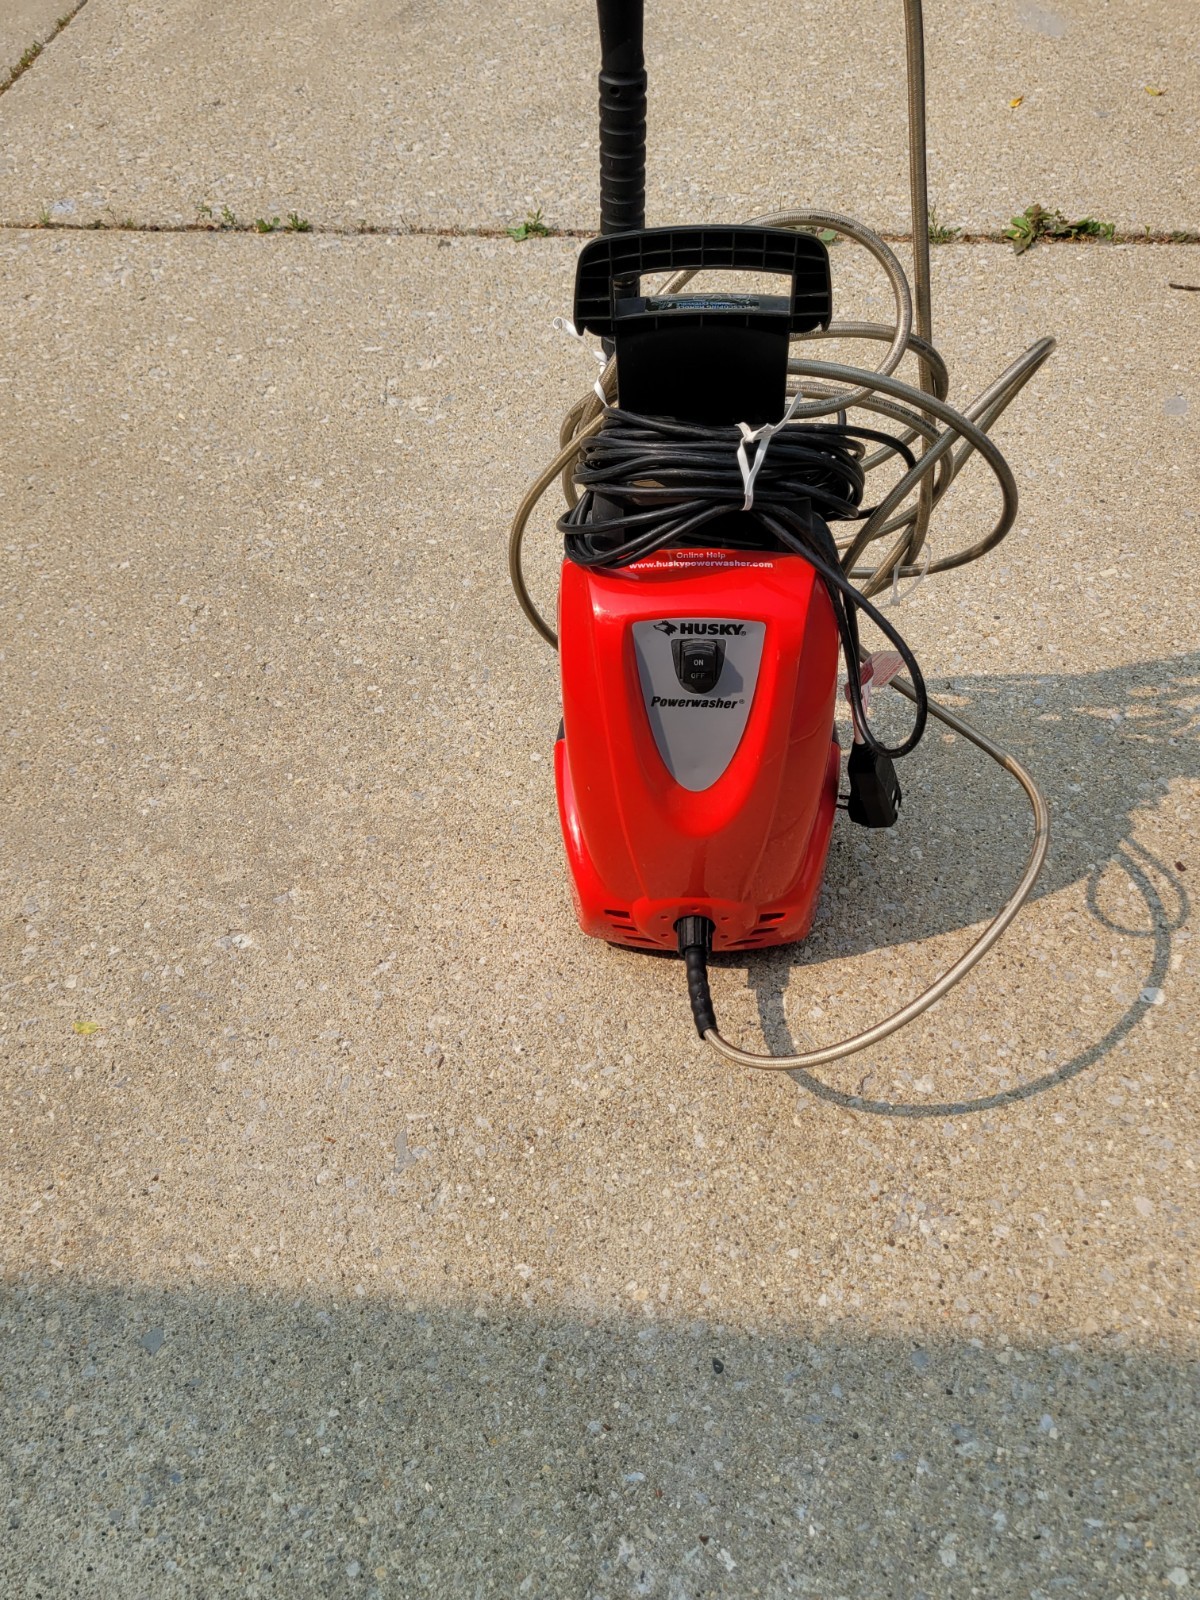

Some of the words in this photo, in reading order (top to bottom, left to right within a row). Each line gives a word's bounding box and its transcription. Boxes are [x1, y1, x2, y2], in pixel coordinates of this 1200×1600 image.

[706, 551, 726, 559] Help
[629, 559, 773, 569] www.huskypowerwasher.com
[693, 658, 704, 666] ON
